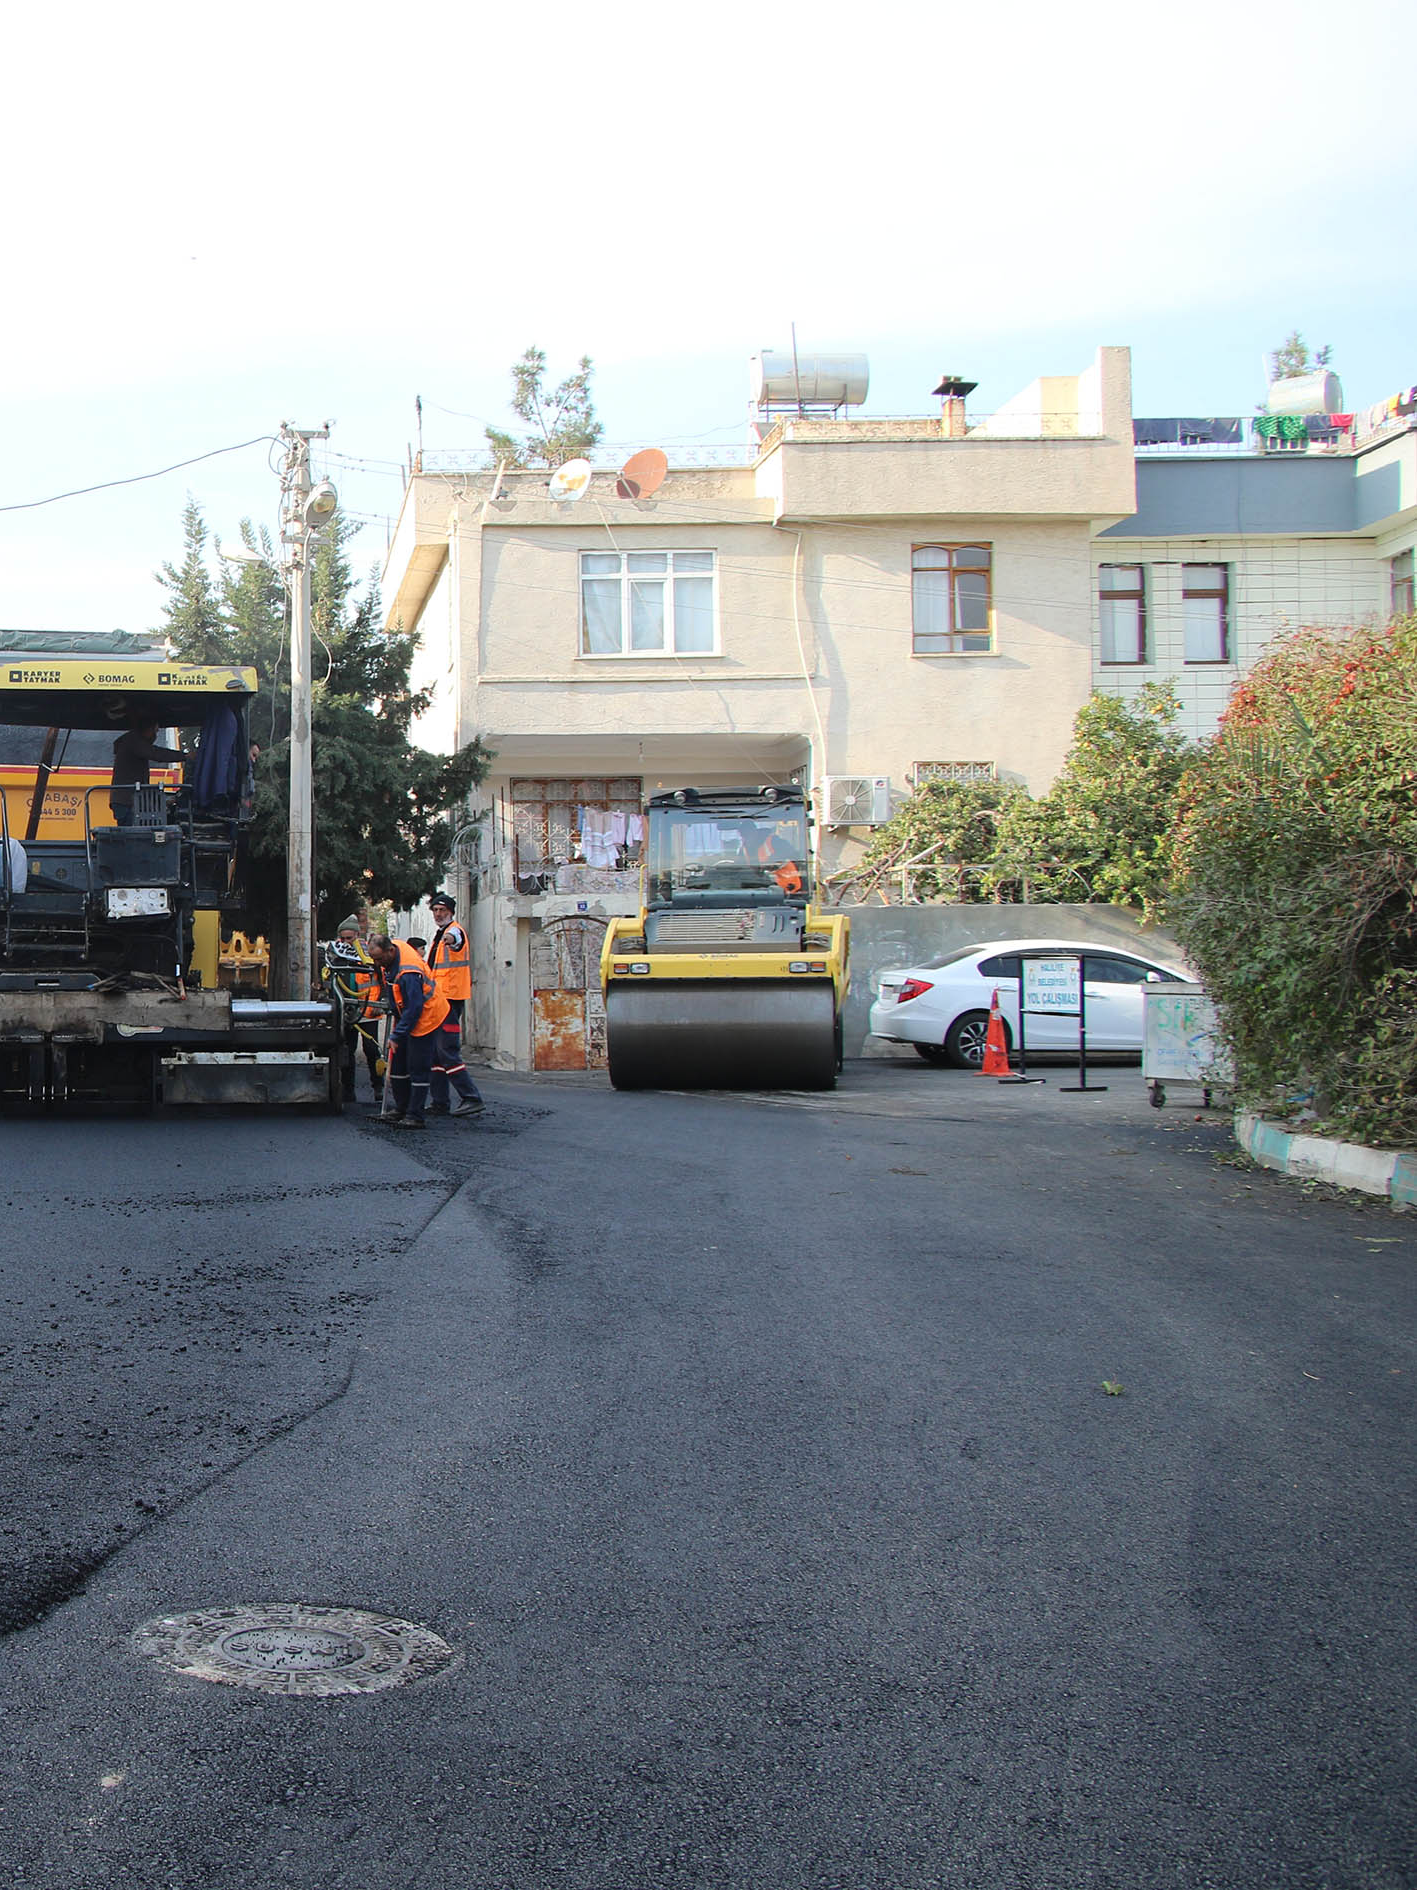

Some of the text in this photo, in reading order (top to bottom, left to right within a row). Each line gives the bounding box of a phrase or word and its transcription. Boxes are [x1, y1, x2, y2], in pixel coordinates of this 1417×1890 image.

[98, 675, 135, 683] BOMAG
[54, 808, 60, 816] 5
[61, 808, 77, 816] 300
[1026, 992, 1041, 1004] YOL
